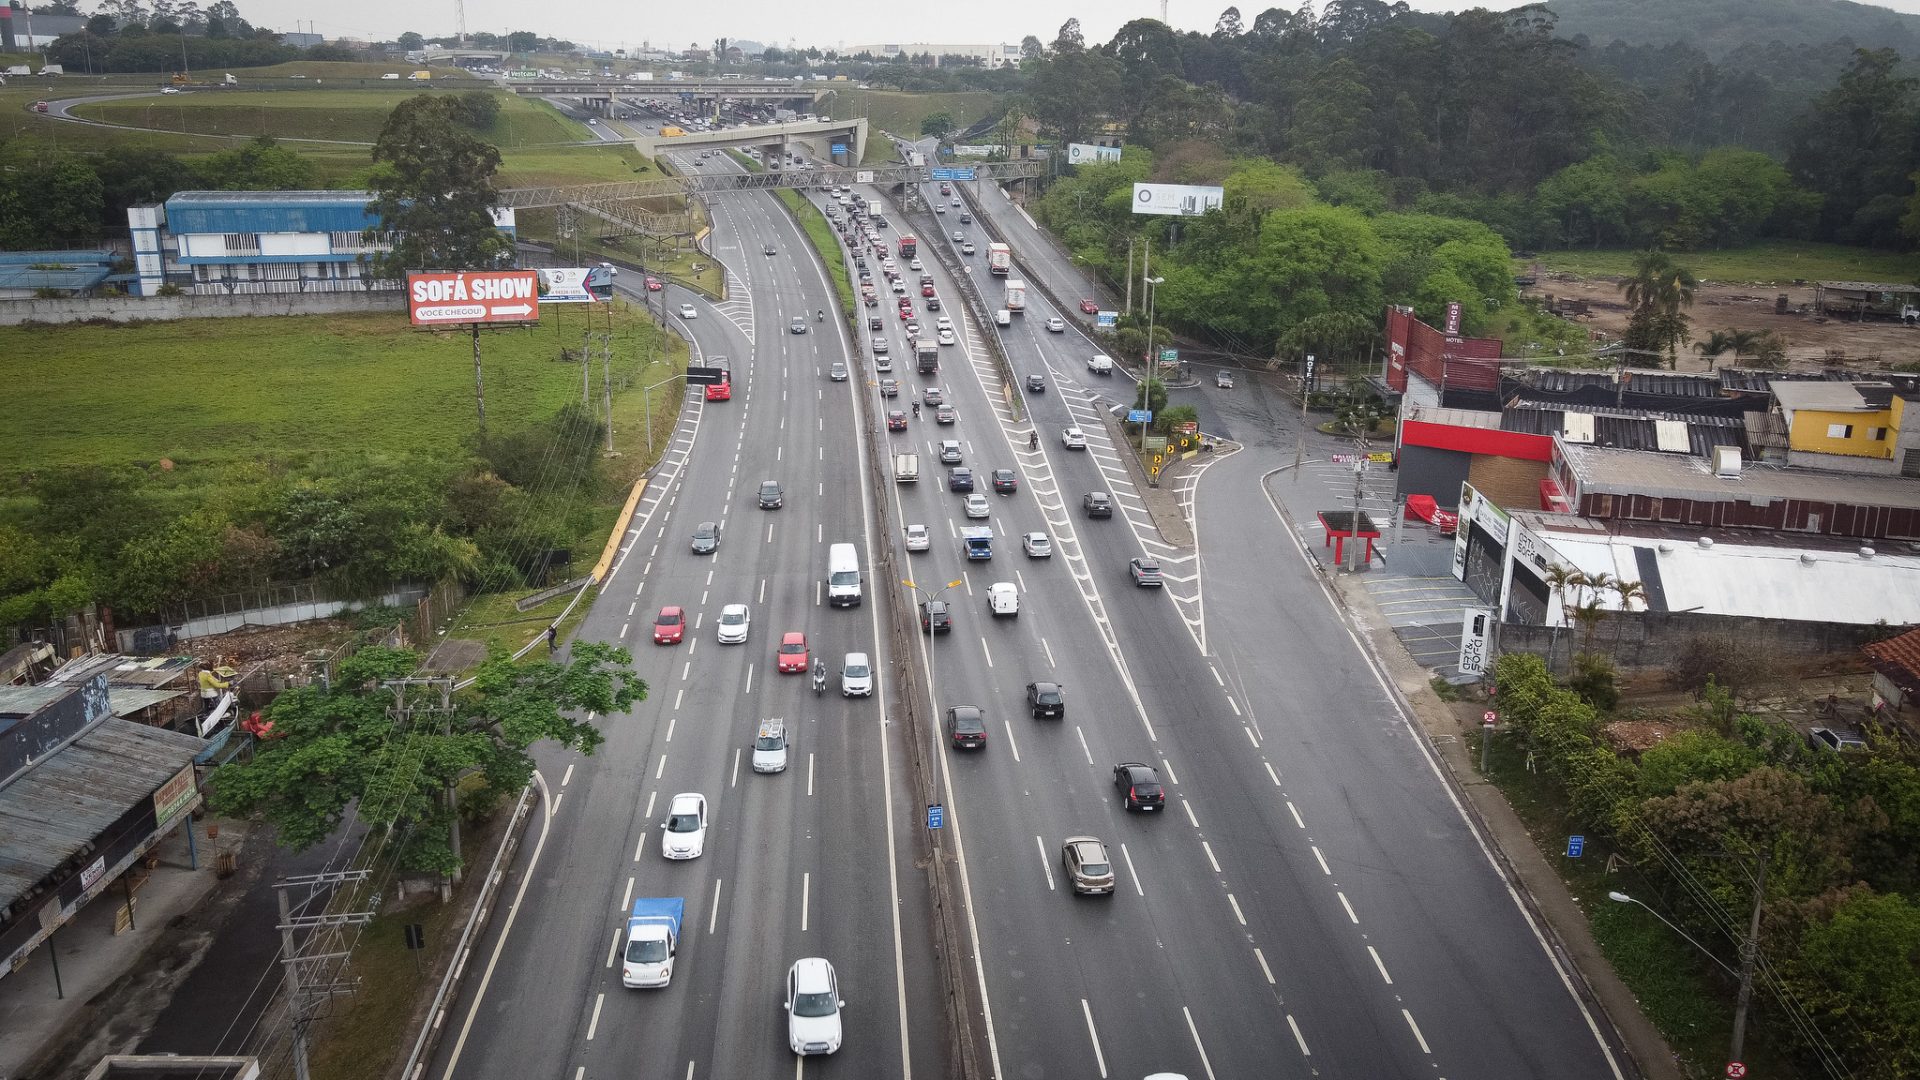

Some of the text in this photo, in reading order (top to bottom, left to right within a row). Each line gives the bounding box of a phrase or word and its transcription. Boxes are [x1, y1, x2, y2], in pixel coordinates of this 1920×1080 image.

[413, 274, 533, 302] SOFÁ SHOW
[1448, 304, 1459, 331] MOTEL
